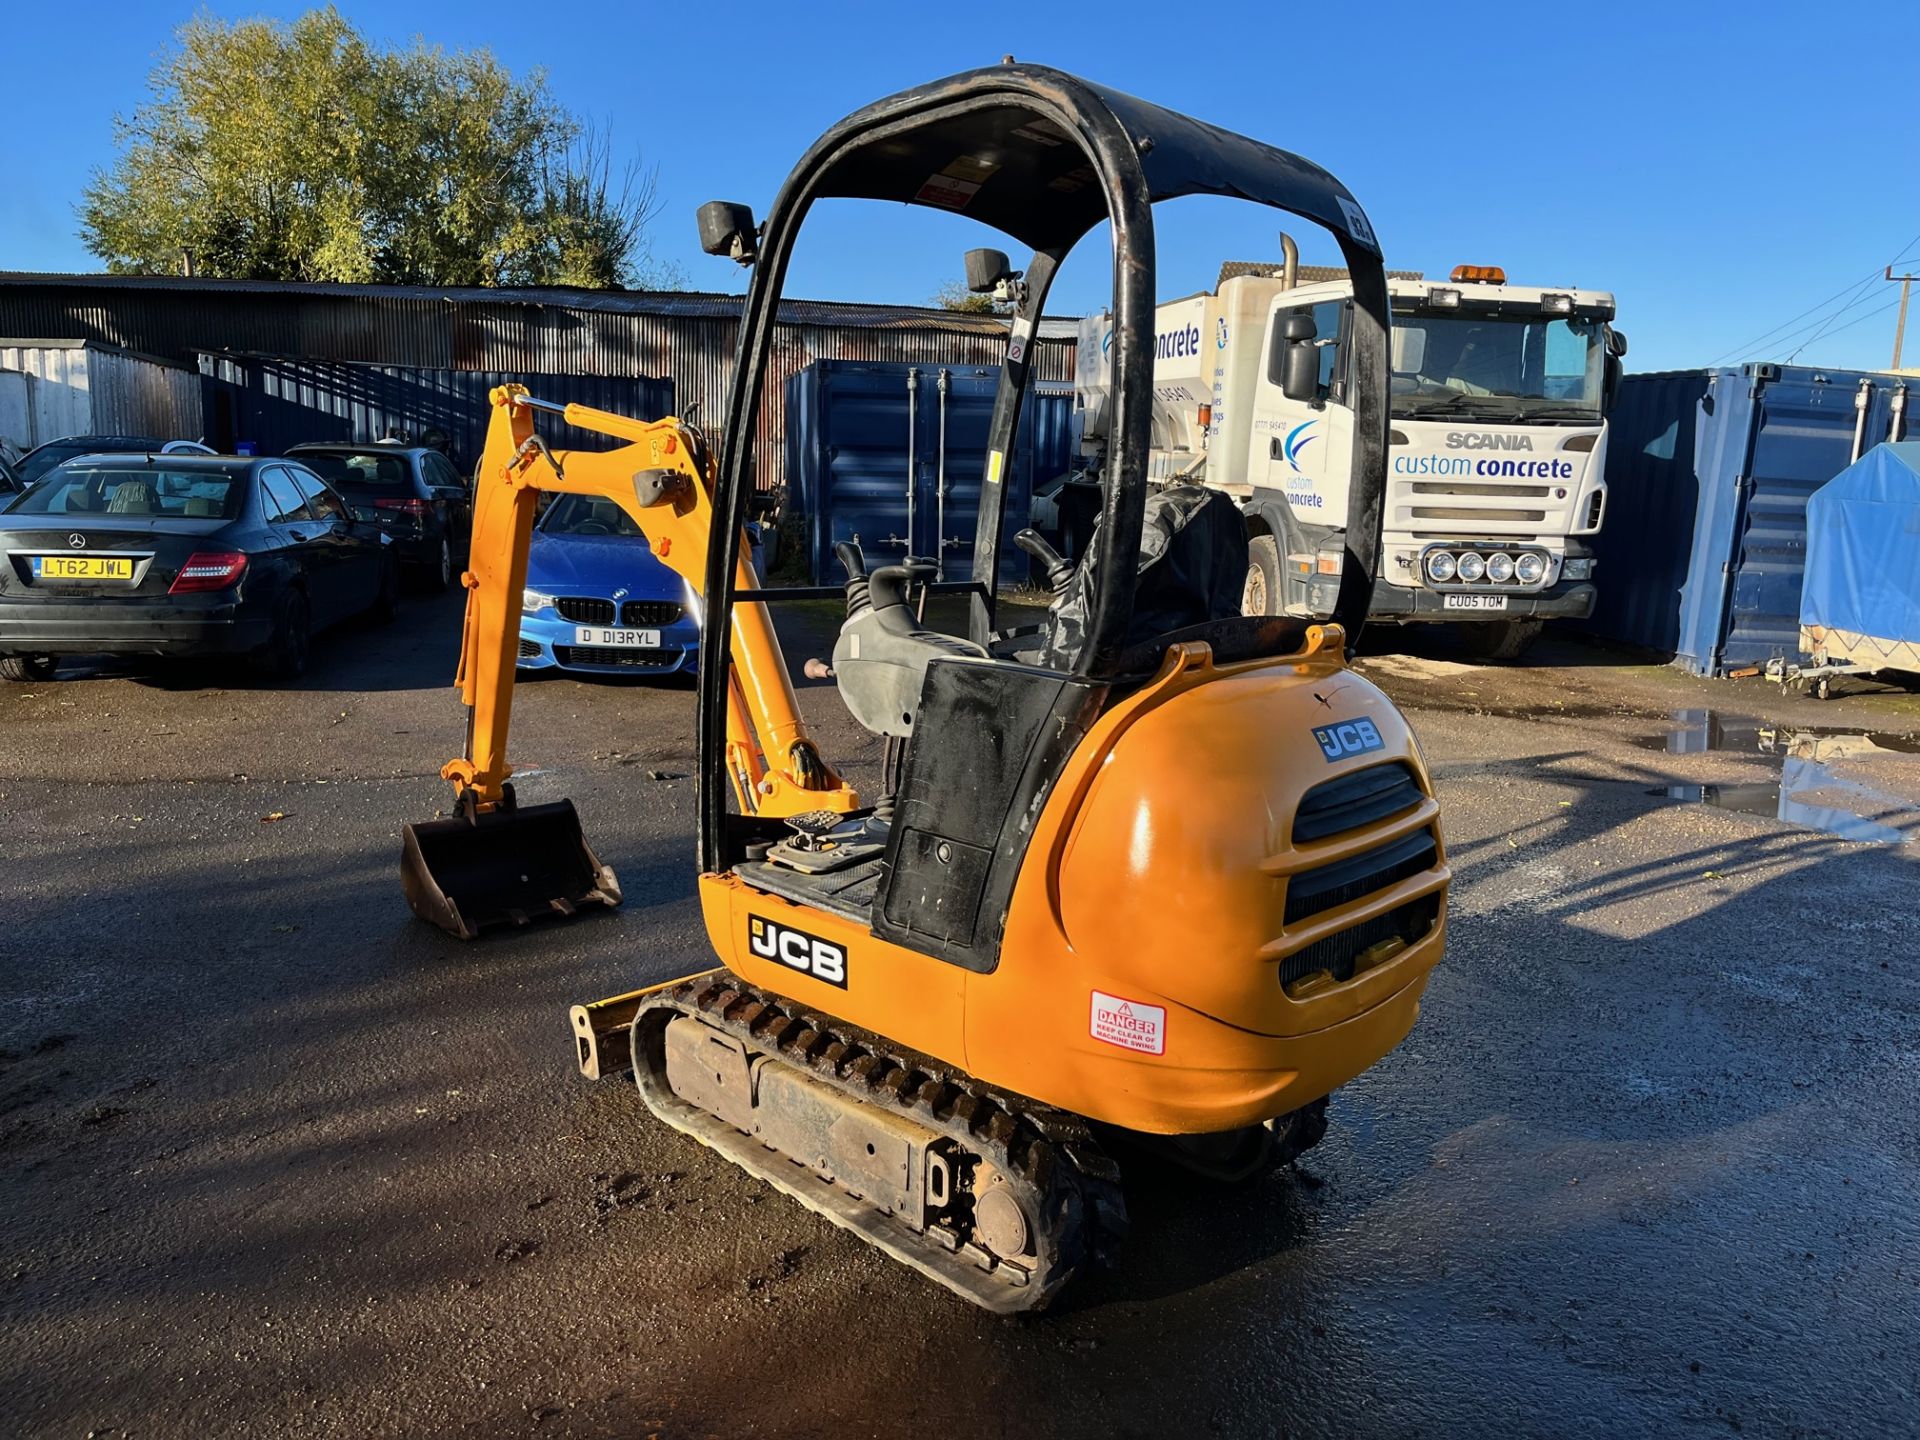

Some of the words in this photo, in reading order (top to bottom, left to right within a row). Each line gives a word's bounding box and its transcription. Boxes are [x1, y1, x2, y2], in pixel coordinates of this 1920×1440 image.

[1154, 322, 1199, 359] oncrete
[1445, 432, 1534, 451] SCANIA
[1395, 454, 1471, 475] custom
[1476, 458, 1573, 479] concrete
[1286, 477, 1313, 490] custom
[1287, 493, 1323, 508] concrete
[44, 559, 90, 576] LT62
[95, 560, 128, 576] JWL
[1448, 595, 1478, 607] CU05
[1482, 596, 1504, 608] TOM
[583, 629, 592, 642] D
[1323, 721, 1381, 757] JCB
[751, 923, 845, 983] JCB
[1096, 1023, 1116, 1033] KEEP
[1117, 1029, 1143, 1041] CLEAR
[1099, 1010, 1155, 1035] DANGER
[1096, 1030, 1129, 1045] MACHINE
[1130, 1039, 1156, 1051] SWING
